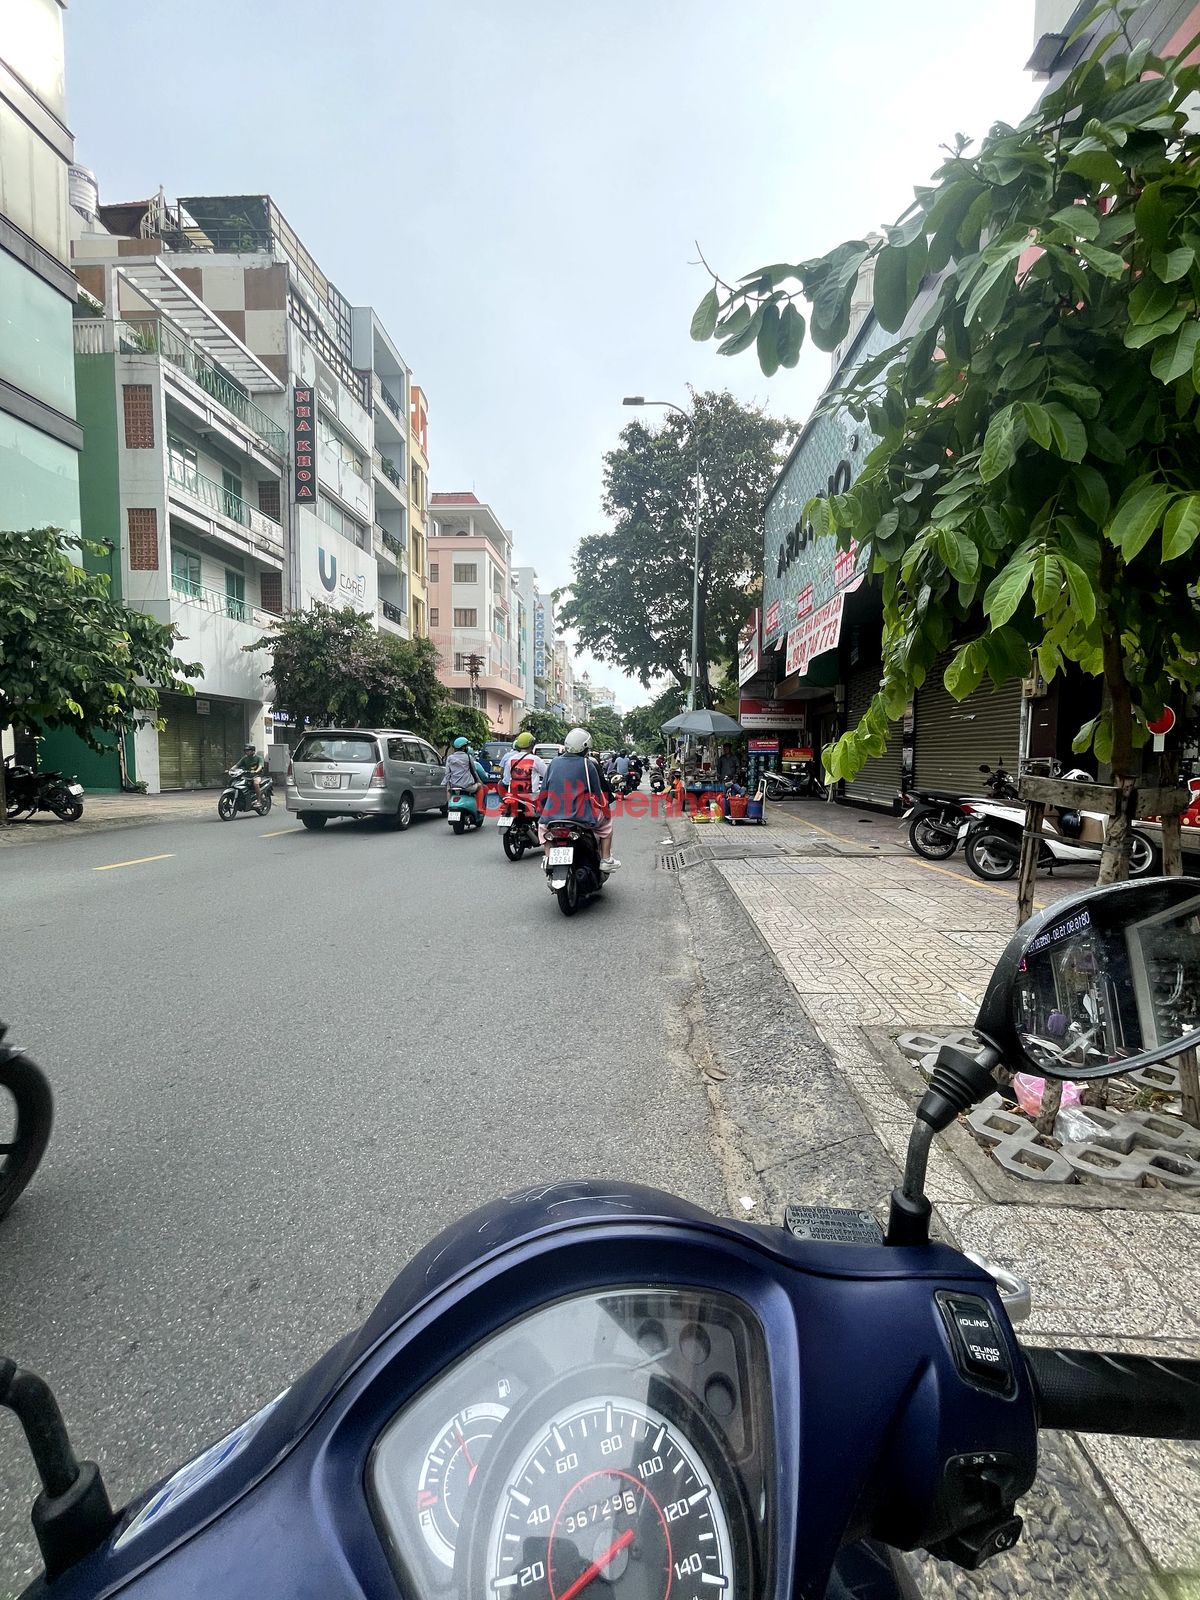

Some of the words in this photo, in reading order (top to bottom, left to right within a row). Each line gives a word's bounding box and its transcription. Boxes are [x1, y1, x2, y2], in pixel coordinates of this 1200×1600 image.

[296, 390, 311, 431] NHA
[297, 440, 312, 497] KHOA
[318, 546, 337, 593] U
[340, 573, 364, 599] CARE
[272, 711, 281, 721] HA
[960, 1318, 989, 1328] IDLING
[969, 1344, 1000, 1356] IDLING
[974, 1351, 1000, 1362] STOP
[464, 1407, 473, 1420] F
[600, 1434, 623, 1455] 80
[555, 1452, 579, 1474] 60
[637, 1455, 664, 1479] 100
[420, 1512, 430, 1527] E
[526, 1504, 551, 1526] 40
[565, 1493, 635, 1534] 367296
[663, 1498, 690, 1523] 120
[519, 1560, 545, 1587] 20
[674, 1552, 703, 1581] 140
